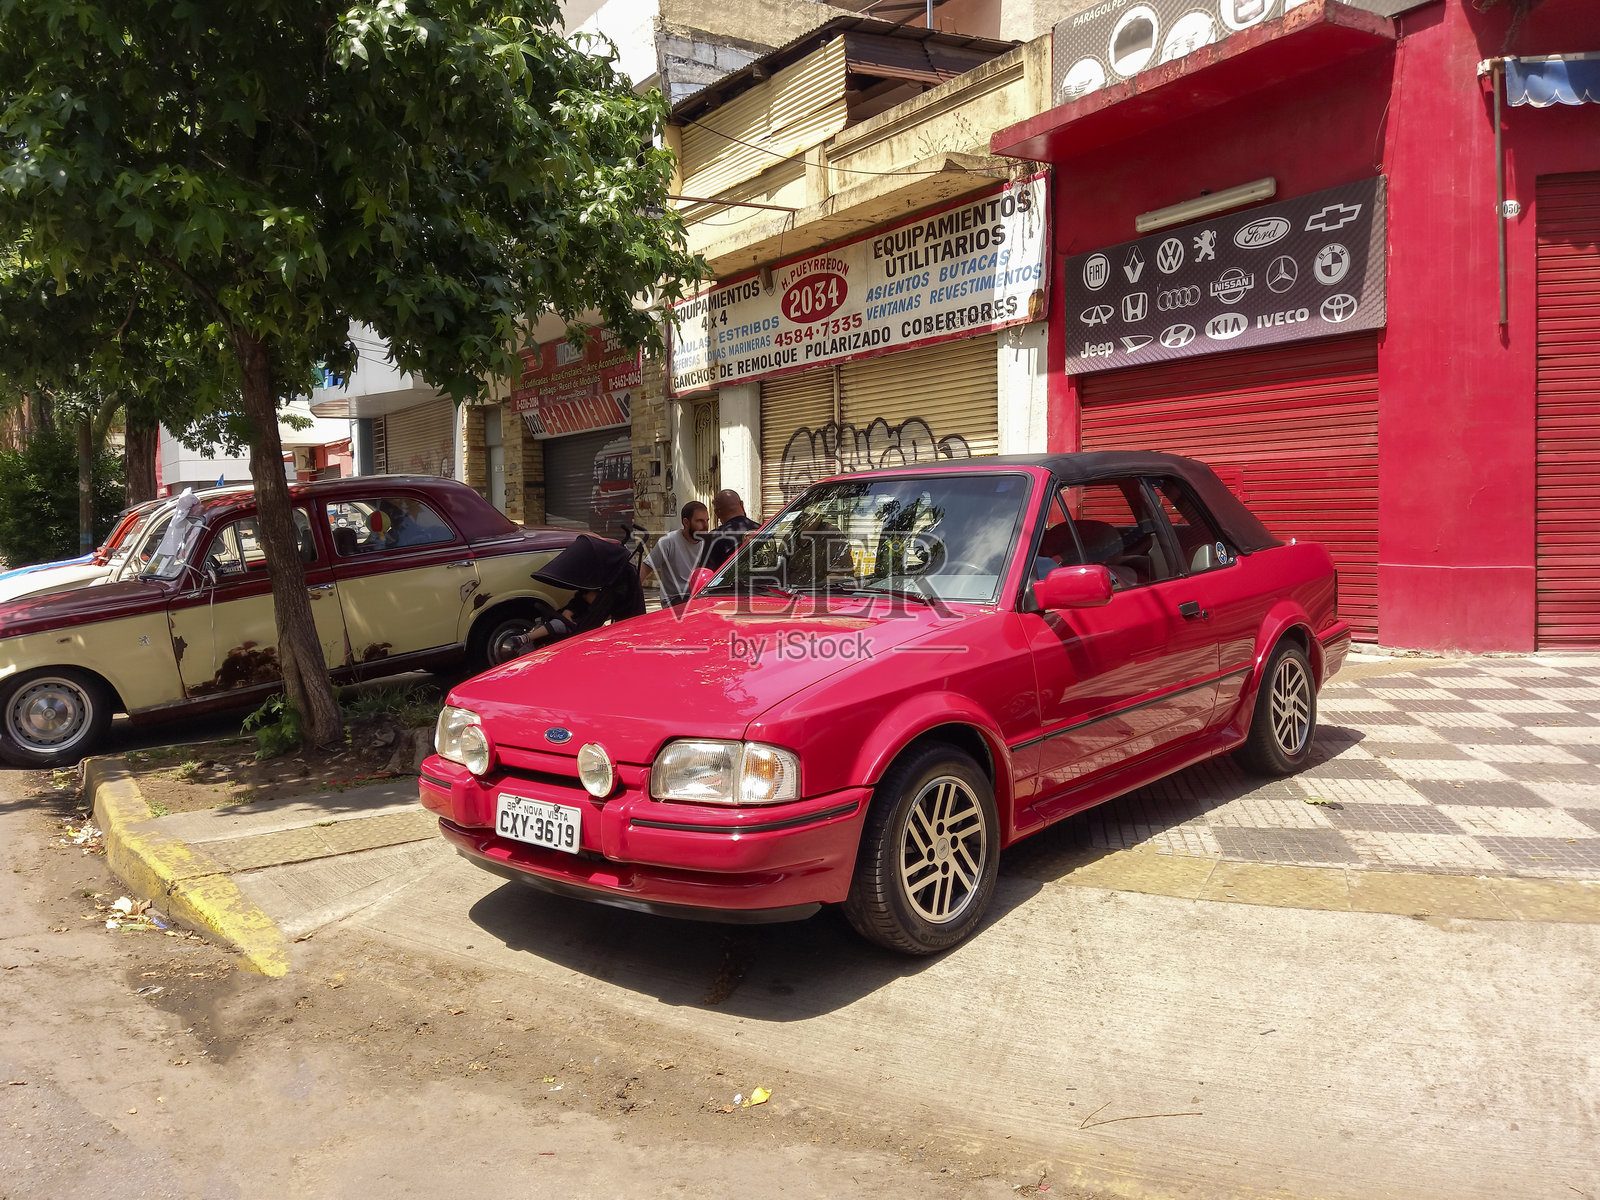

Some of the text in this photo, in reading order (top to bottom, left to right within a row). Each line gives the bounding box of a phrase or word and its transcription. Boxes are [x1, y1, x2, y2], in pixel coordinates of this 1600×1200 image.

[1073, 0, 1127, 27] PARAGOLPES
[1502, 203, 1519, 215] 050
[873, 189, 1031, 260] EQUIPAMIENTOS
[1242, 222, 1280, 243] Ford
[885, 224, 1006, 278] UTILITARIOS
[781, 257, 850, 290] H. PUEYRREDON
[866, 249, 1011, 302] ASIENTOS BUTACAS
[1088, 263, 1105, 281] FIAT
[1214, 276, 1250, 292] NISSAN
[675, 280, 760, 323] EQUIPAMIENTOS
[789, 280, 840, 319] 2034
[866, 295, 922, 322] VENTANAS
[929, 262, 1043, 305] REVESTIMIENTOS
[1211, 318, 1242, 335] KIA
[1257, 307, 1310, 329] IVECO
[673, 368, 716, 390] GANCHOS
[720, 363, 733, 378] DE
[737, 347, 798, 375] REMOLQUE
[805, 326, 891, 360] POLARIZADO
[901, 295, 1018, 338] COBERTORES
[674, 315, 780, 357] JAULAS ESTRIBOS
[704, 348, 727, 363] LONAS
[728, 335, 771, 357] MARINERAS
[1080, 340, 1114, 359] Jeep
[538, 393, 627, 436] CERRAJERIA
[507, 801, 517, 812] BR
[524, 805, 543, 817] NOVA
[547, 810, 569, 822] VISTA
